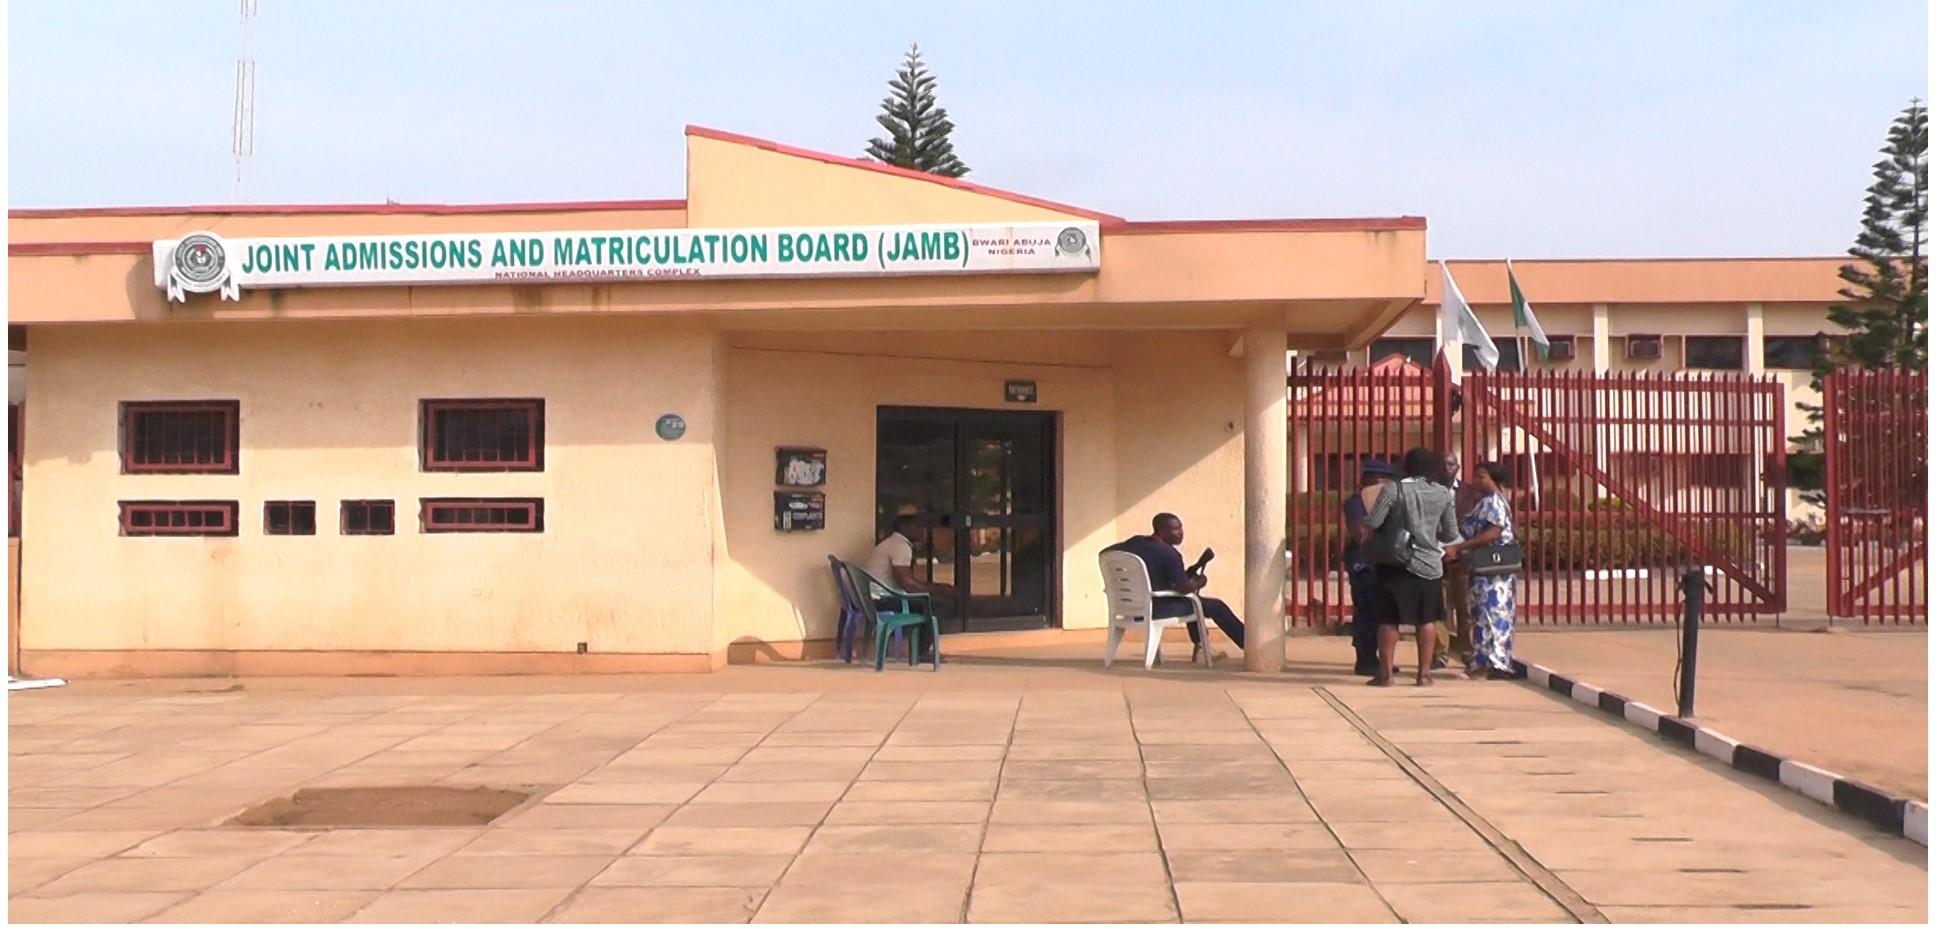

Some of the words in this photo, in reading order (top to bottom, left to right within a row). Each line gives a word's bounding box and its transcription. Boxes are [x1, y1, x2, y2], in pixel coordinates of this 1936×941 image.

[242, 244, 315, 273] JOINT
[324, 239, 482, 270] ADMISSIONS
[491, 238, 544, 267] AND
[554, 233, 767, 266] MATRICULATION
[778, 232, 868, 262] BOARD
[878, 231, 969, 269] (JAMB)
[495, 270, 550, 279] NATIONAL
[554, 269, 643, 278] HEADQUARTERS
[647, 268, 701, 277] COMPLEX
